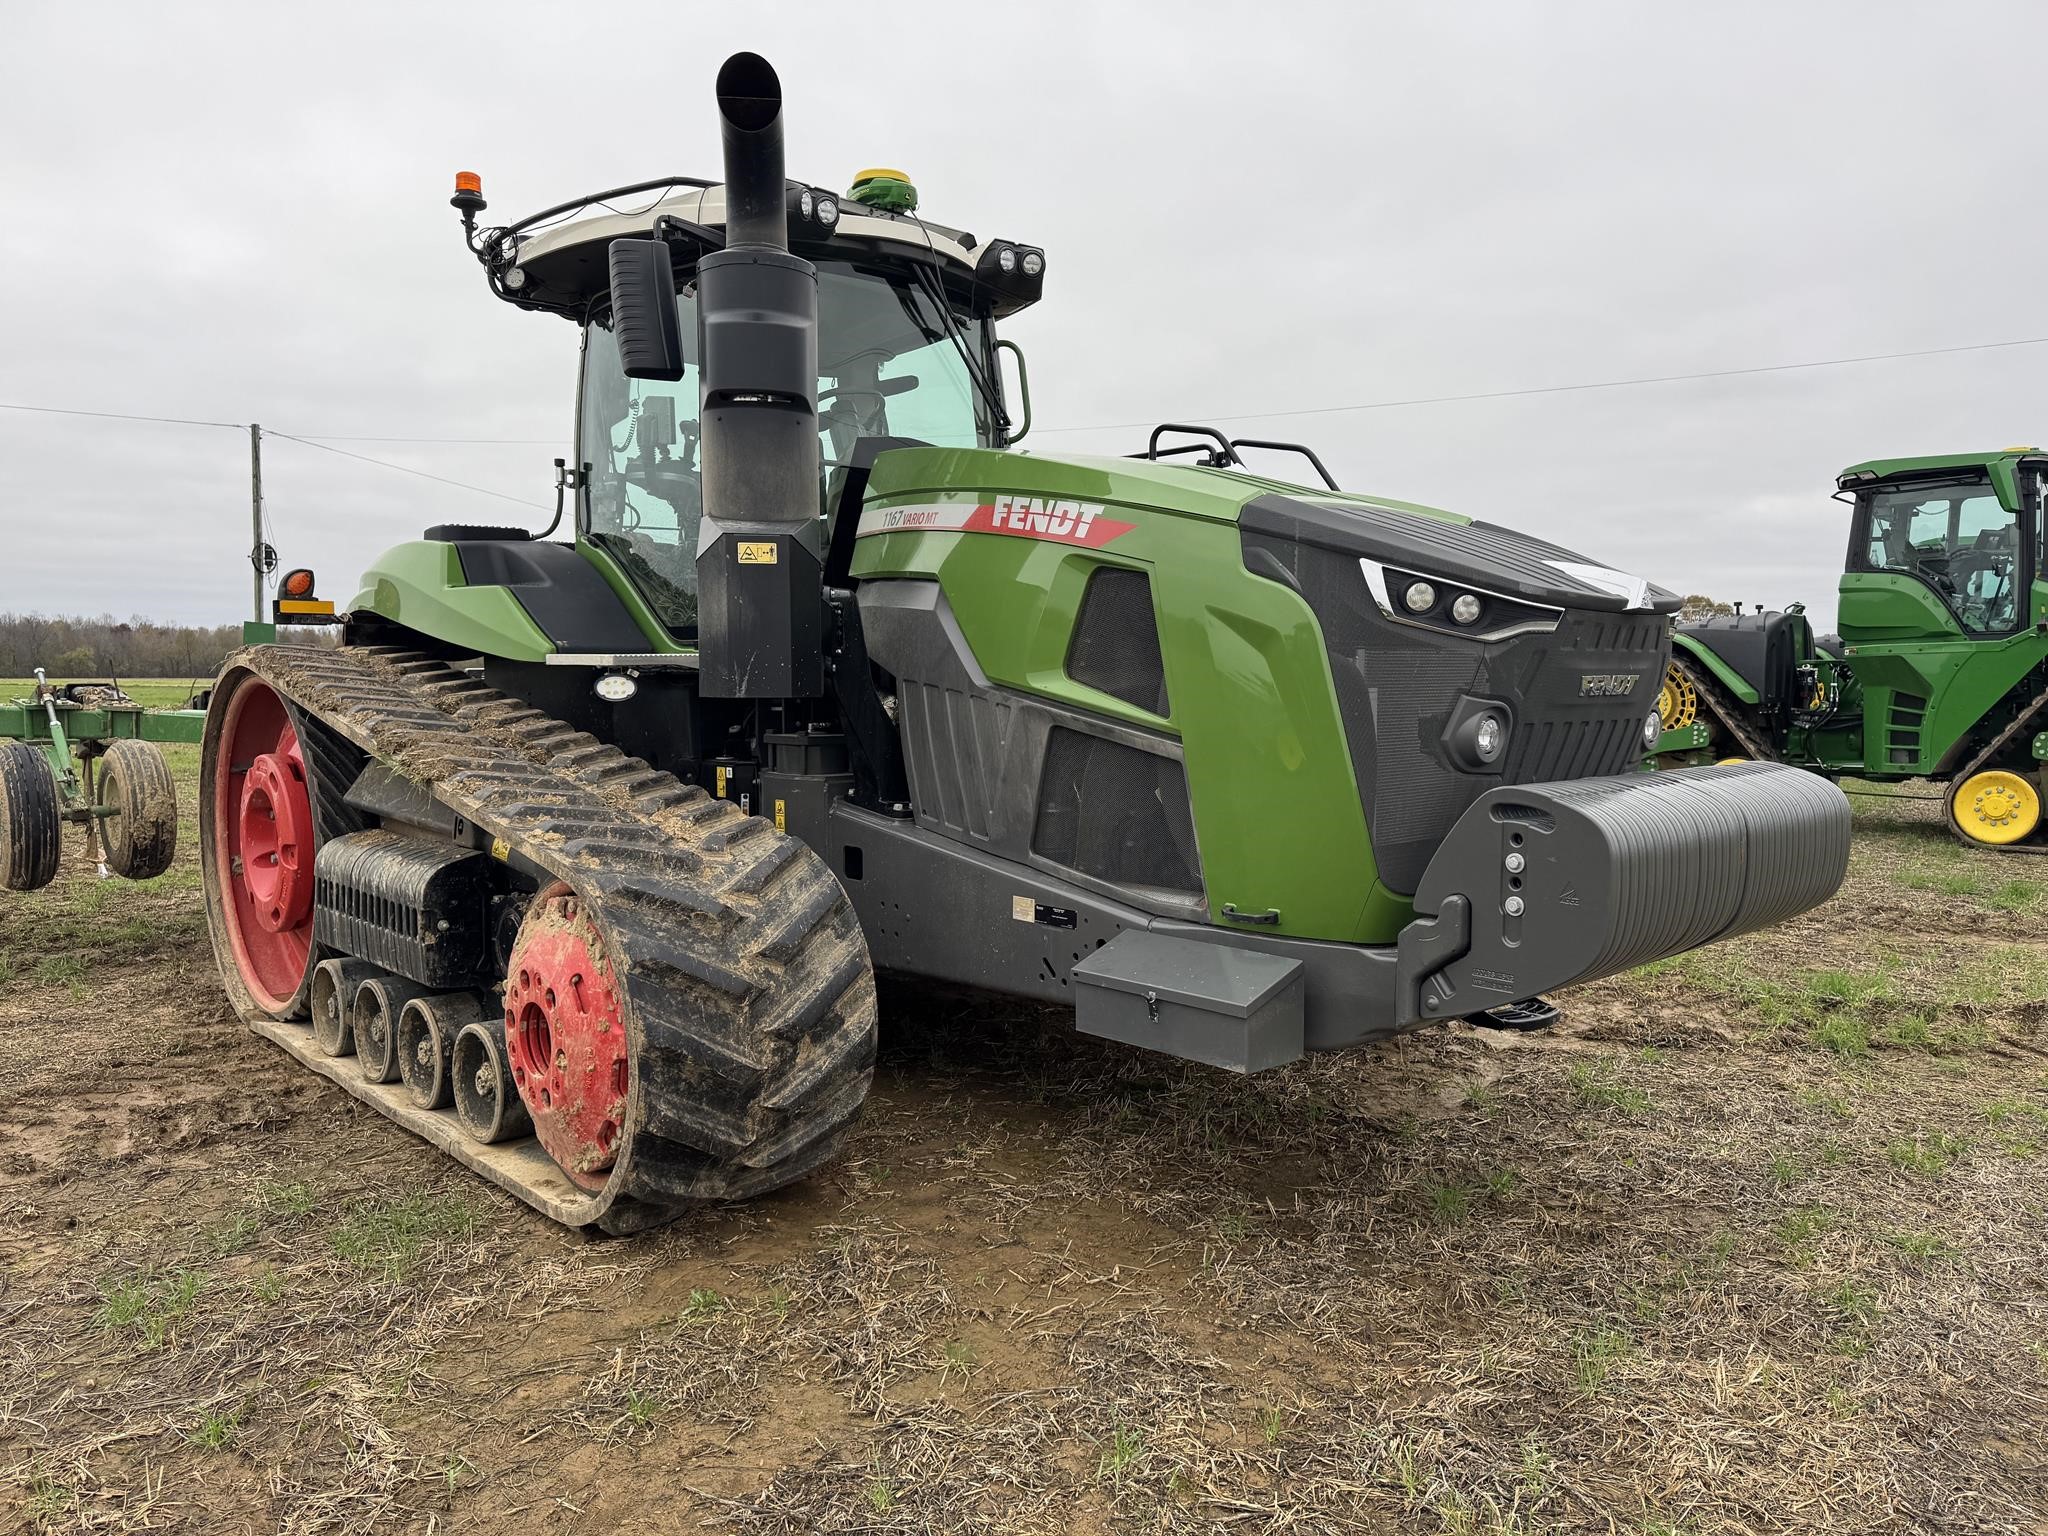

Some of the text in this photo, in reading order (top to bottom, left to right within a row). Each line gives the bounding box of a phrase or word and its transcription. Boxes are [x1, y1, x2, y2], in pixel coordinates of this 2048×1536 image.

[883, 510, 939, 527] 1167 VARIO MT
[992, 495, 1104, 538] FENDT
[1579, 674, 1640, 697] FENDT
